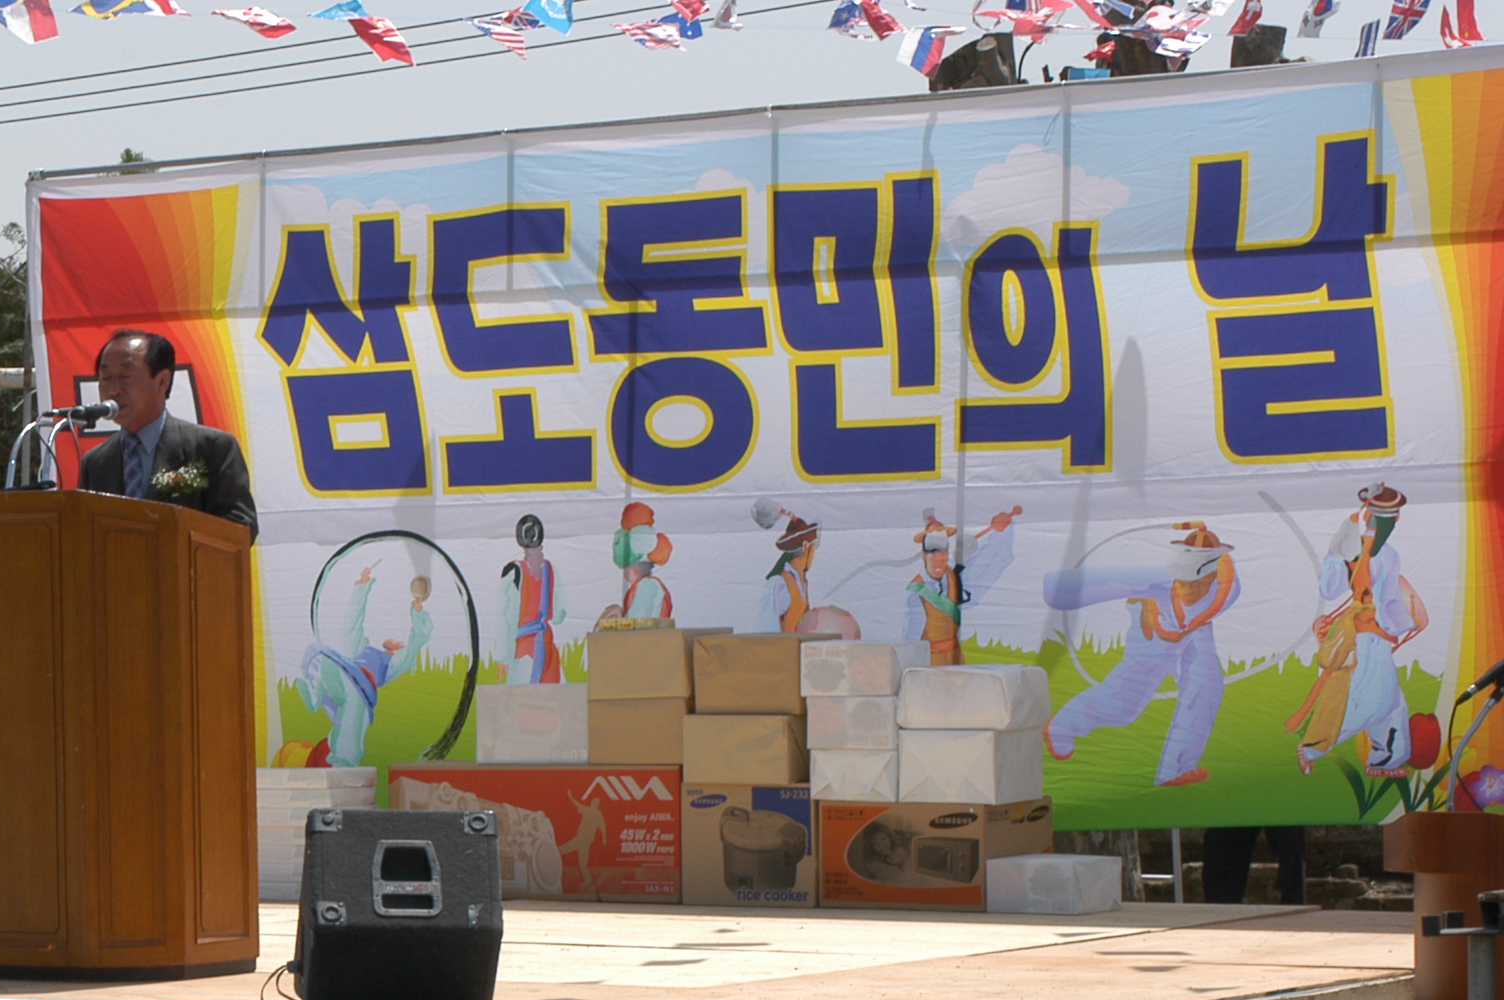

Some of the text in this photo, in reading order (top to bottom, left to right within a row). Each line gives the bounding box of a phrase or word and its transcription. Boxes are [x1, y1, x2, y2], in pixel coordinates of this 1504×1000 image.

[257, 129, 1395, 496] 삼도동민의 날
[624, 813, 647, 823] enjoy
[934, 814, 976, 825] SAMSUNG
[737, 887, 762, 901] rice
[764, 887, 809, 902] cooker
